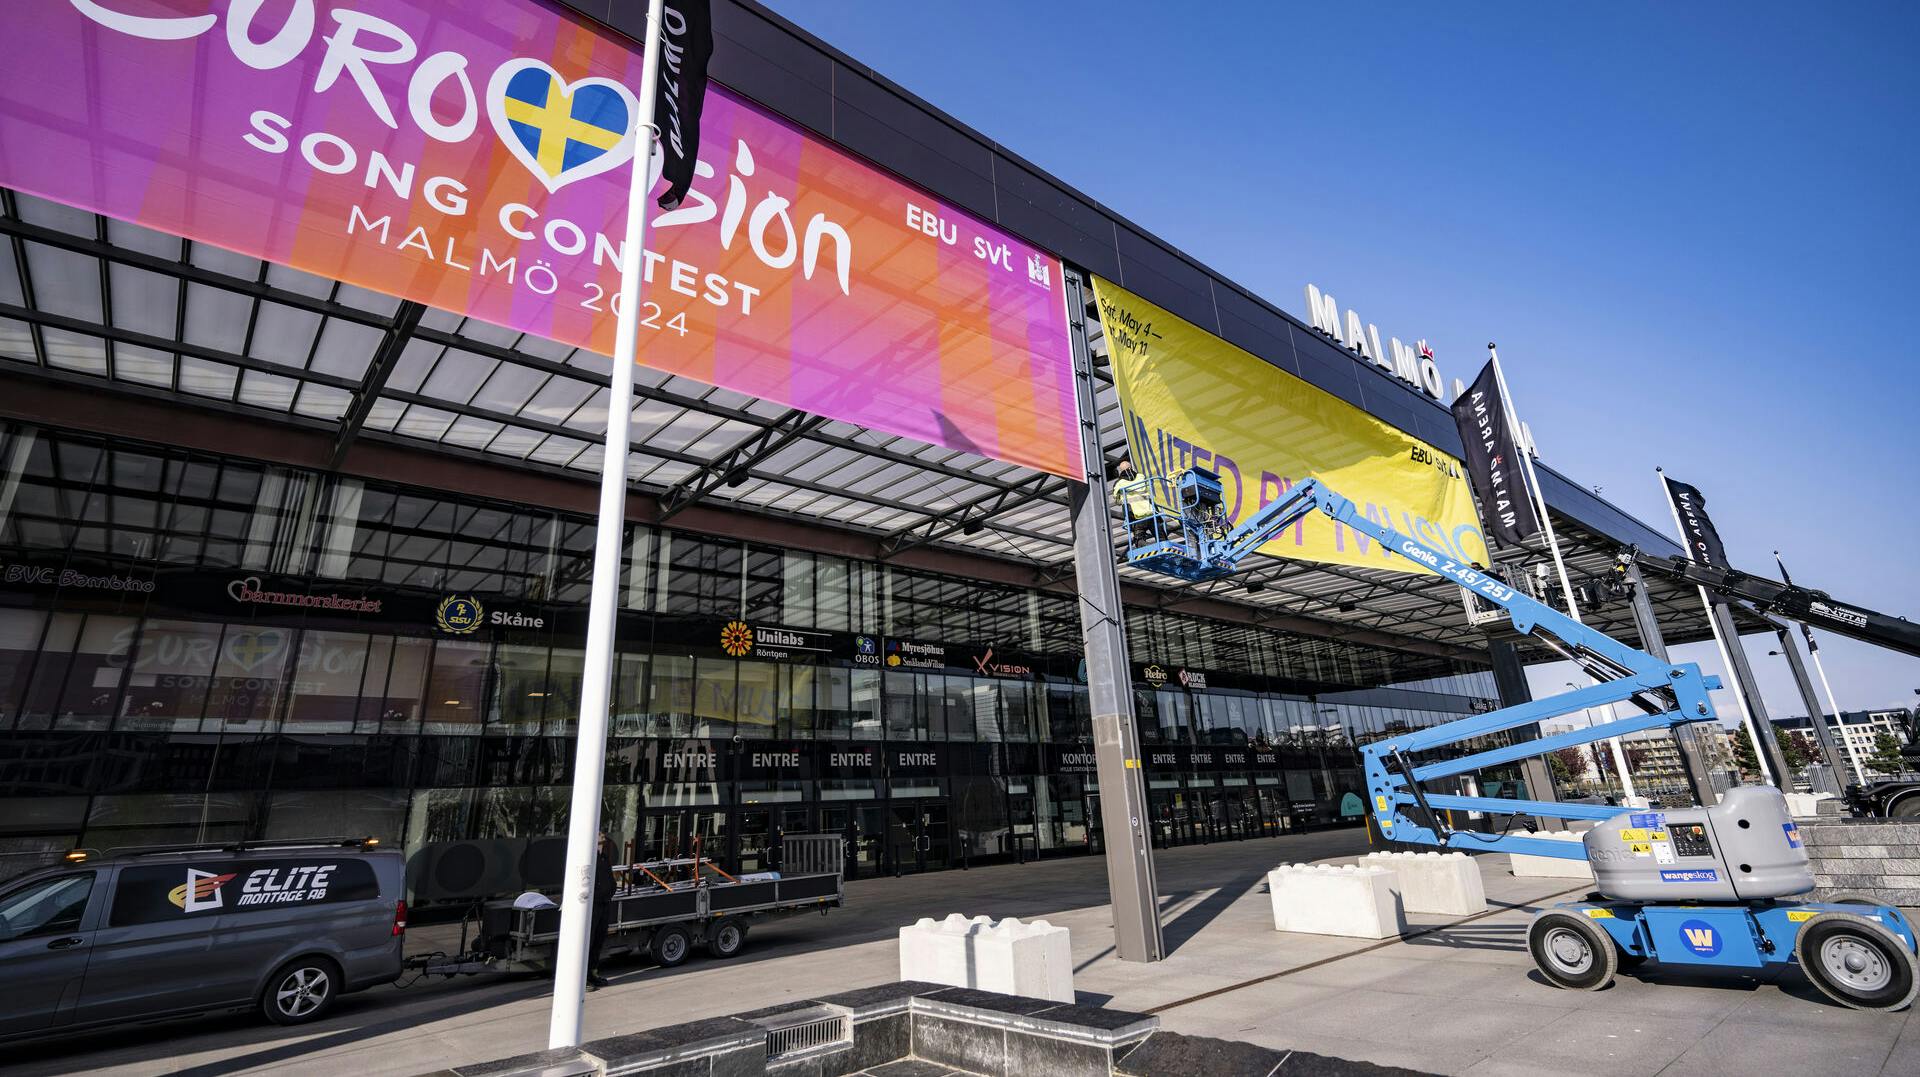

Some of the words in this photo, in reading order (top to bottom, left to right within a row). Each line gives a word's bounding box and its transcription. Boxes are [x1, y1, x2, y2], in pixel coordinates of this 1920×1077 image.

[242, 110, 469, 216] SONG
[498, 202, 761, 316] CONTEST
[347, 204, 558, 296] MALMÖ
[906, 202, 957, 246] EBU
[973, 236, 1014, 272] svt
[1119, 309, 1143, 336] May
[1117, 329, 1138, 354] May
[1139, 341, 1149, 356] 11
[1129, 409, 1244, 528] NITD
[1410, 446, 1433, 466] EBU
[1679, 492, 1702, 537] ARENA
[4, 564, 55, 585] BVC
[58, 569, 156, 593] Bambino
[1402, 541, 1438, 567] Genie
[1440, 560, 1515, 602] Z-45/25J
[241, 584, 383, 614] barnmorskeriet
[491, 611, 544, 629] Skåne
[756, 629, 805, 647] Unilabs
[756, 648, 788, 661] Röntgen
[855, 654, 880, 665] OBOS
[242, 864, 338, 893] ELITE
[1662, 871, 1716, 881] wangeskog
[237, 890, 307, 907] MONTAGE
[307, 887, 326, 900] AB
[1684, 928, 1713, 947] W
